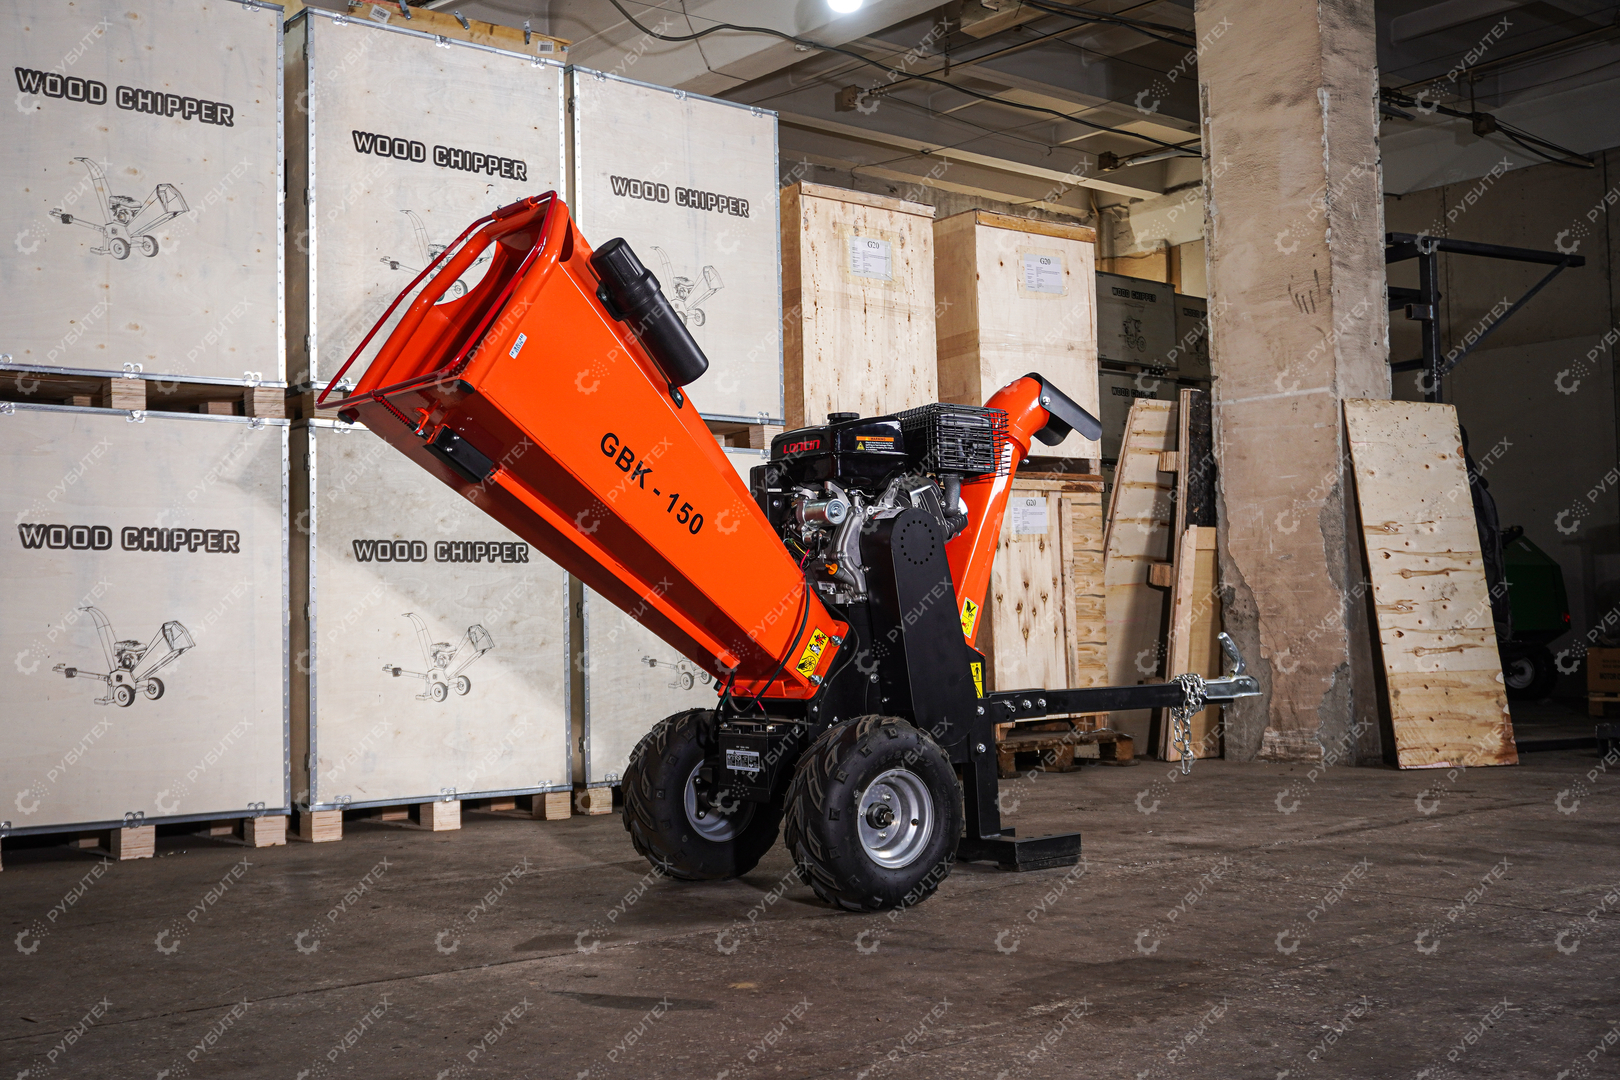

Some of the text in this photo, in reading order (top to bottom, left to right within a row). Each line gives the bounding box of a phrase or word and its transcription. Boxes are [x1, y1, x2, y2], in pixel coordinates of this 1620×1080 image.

[15, 67, 235, 127] WOOD CHIPPER
[352, 130, 527, 181] WOOD CHIPPER
[610, 175, 749, 218] WOOD CHIPPER
[867, 240, 880, 249] G20
[1039, 257, 1051, 265] G20
[1112, 287, 1157, 303] WOOD CHIPPER
[600, 432, 653, 490] GBK
[667, 493, 704, 535] 150
[17, 523, 240, 553] WOOD CHIPPER
[352, 539, 529, 563] WOOD CHIPPER
